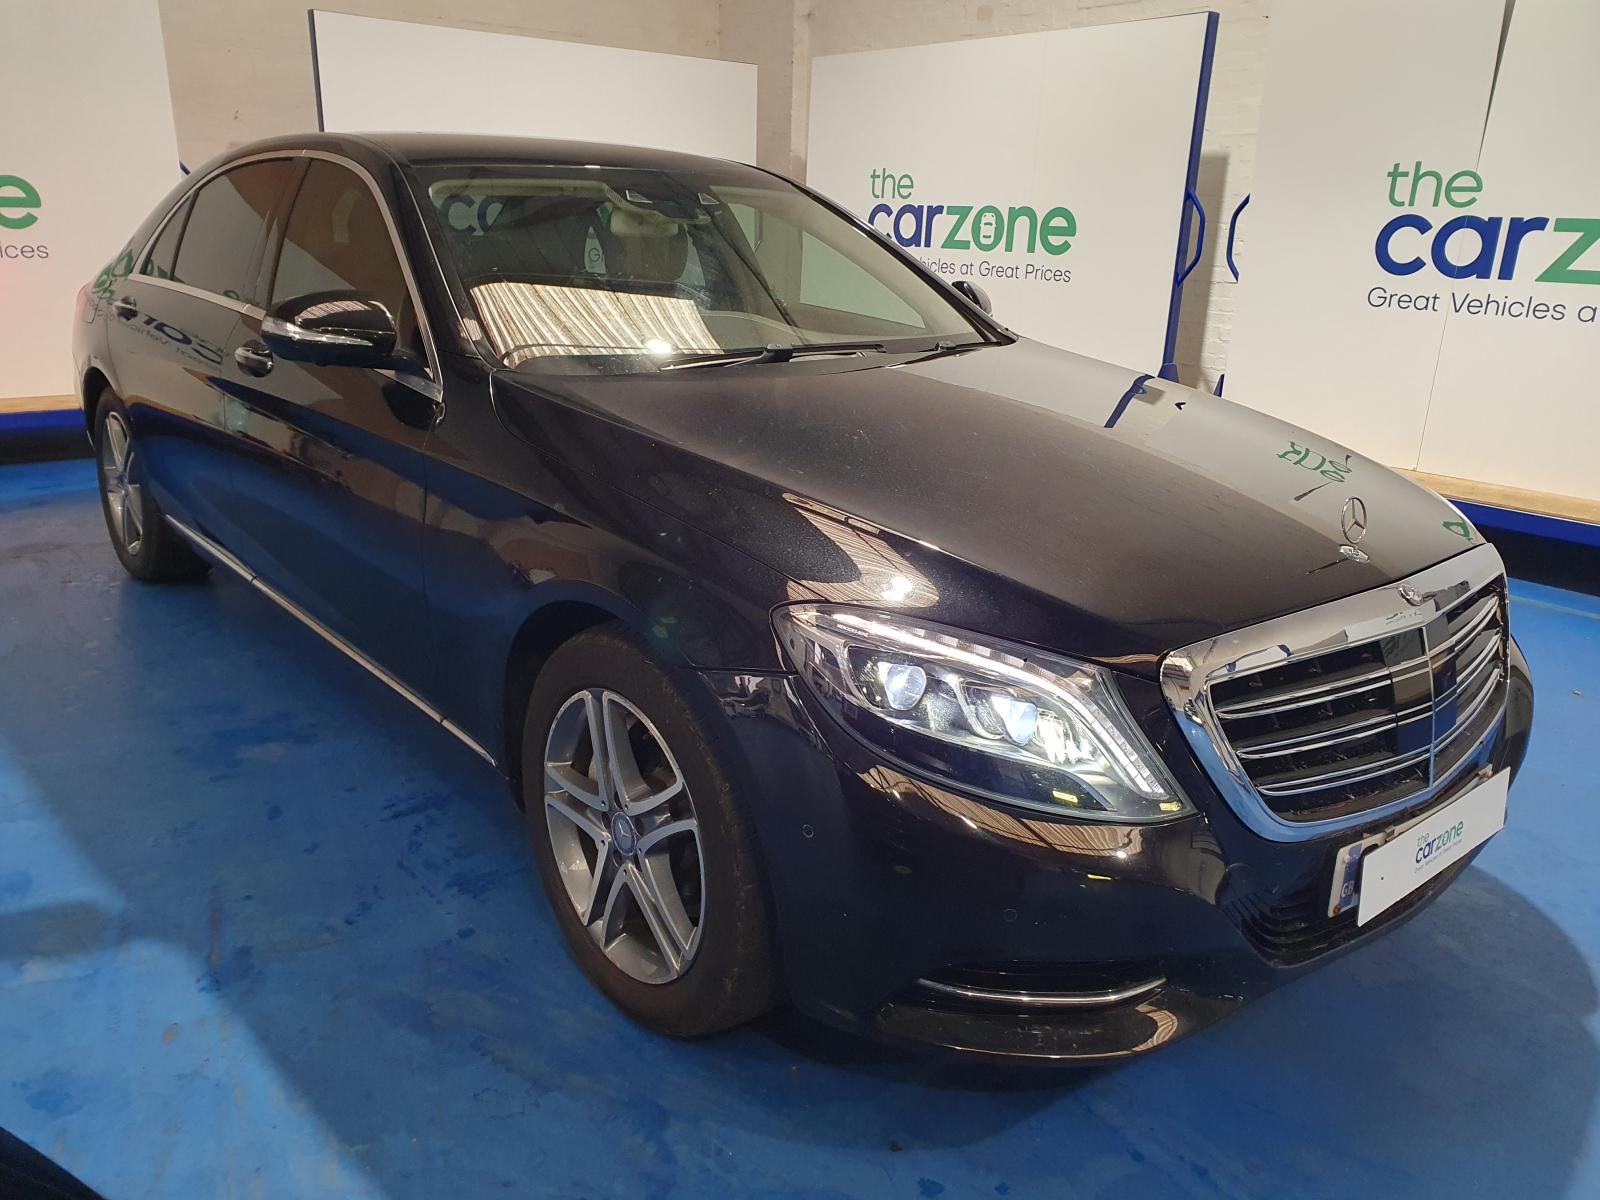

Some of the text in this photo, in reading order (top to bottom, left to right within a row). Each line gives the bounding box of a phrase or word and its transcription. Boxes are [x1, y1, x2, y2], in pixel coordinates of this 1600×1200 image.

[870, 168, 914, 199] the
[1387, 161, 1483, 208] the
[868, 203, 1077, 256] carzone
[960, 262, 974, 276] at
[979, 260, 1020, 280] Great
[1025, 263, 1072, 283] Prices
[1367, 286, 1440, 312] Great
[1451, 292, 1567, 321] Vehicles
[1415, 820, 1464, 864] carzone
[1416, 832, 1430, 848] the
